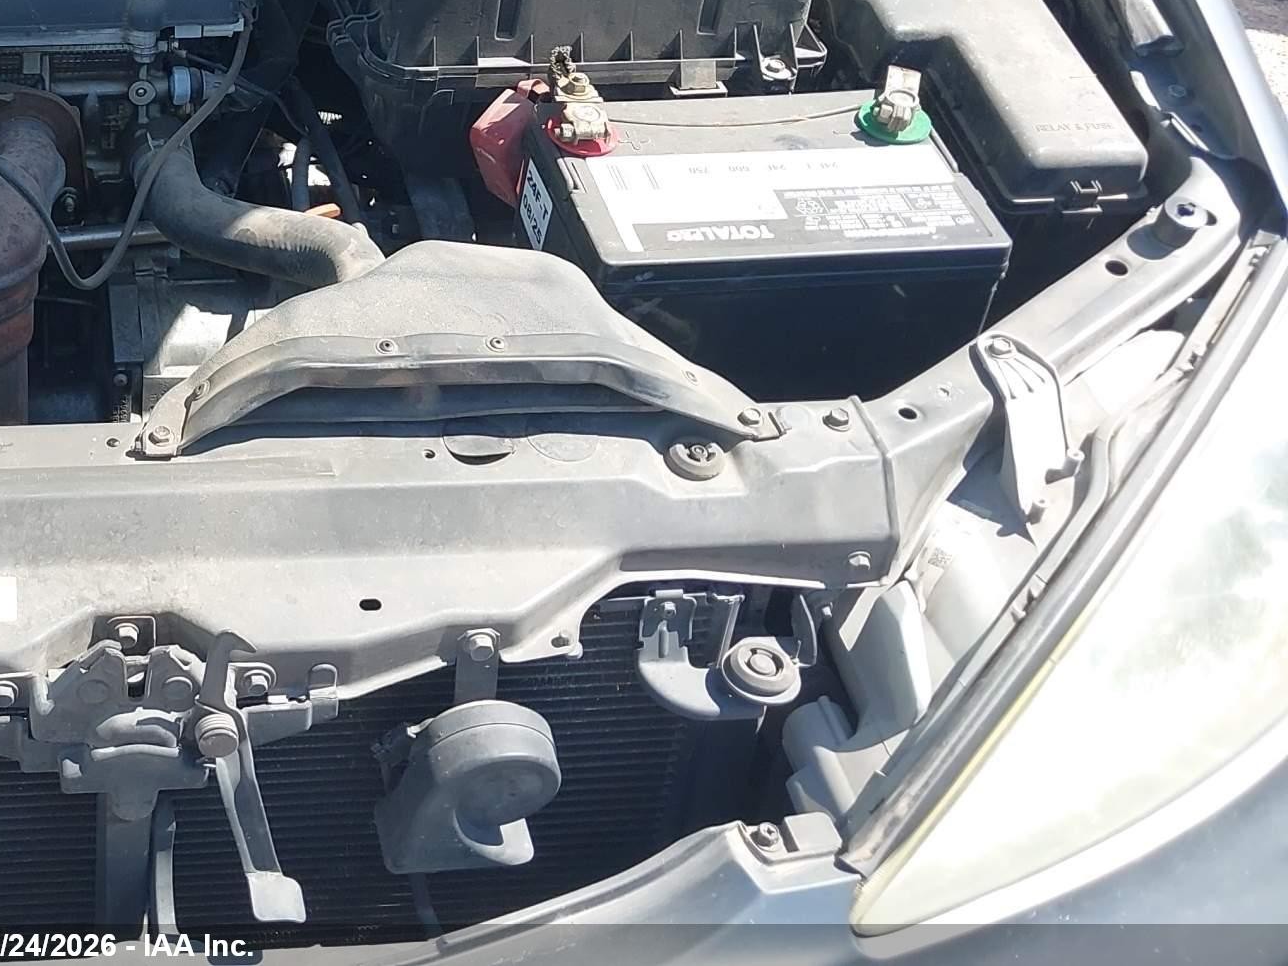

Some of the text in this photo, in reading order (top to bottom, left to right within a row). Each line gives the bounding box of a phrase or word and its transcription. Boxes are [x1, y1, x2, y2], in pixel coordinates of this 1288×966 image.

[1031, 121, 1071, 133] RELAY
[522, 193, 542, 245] 08/25
[526, 170, 549, 221] 24F-T
